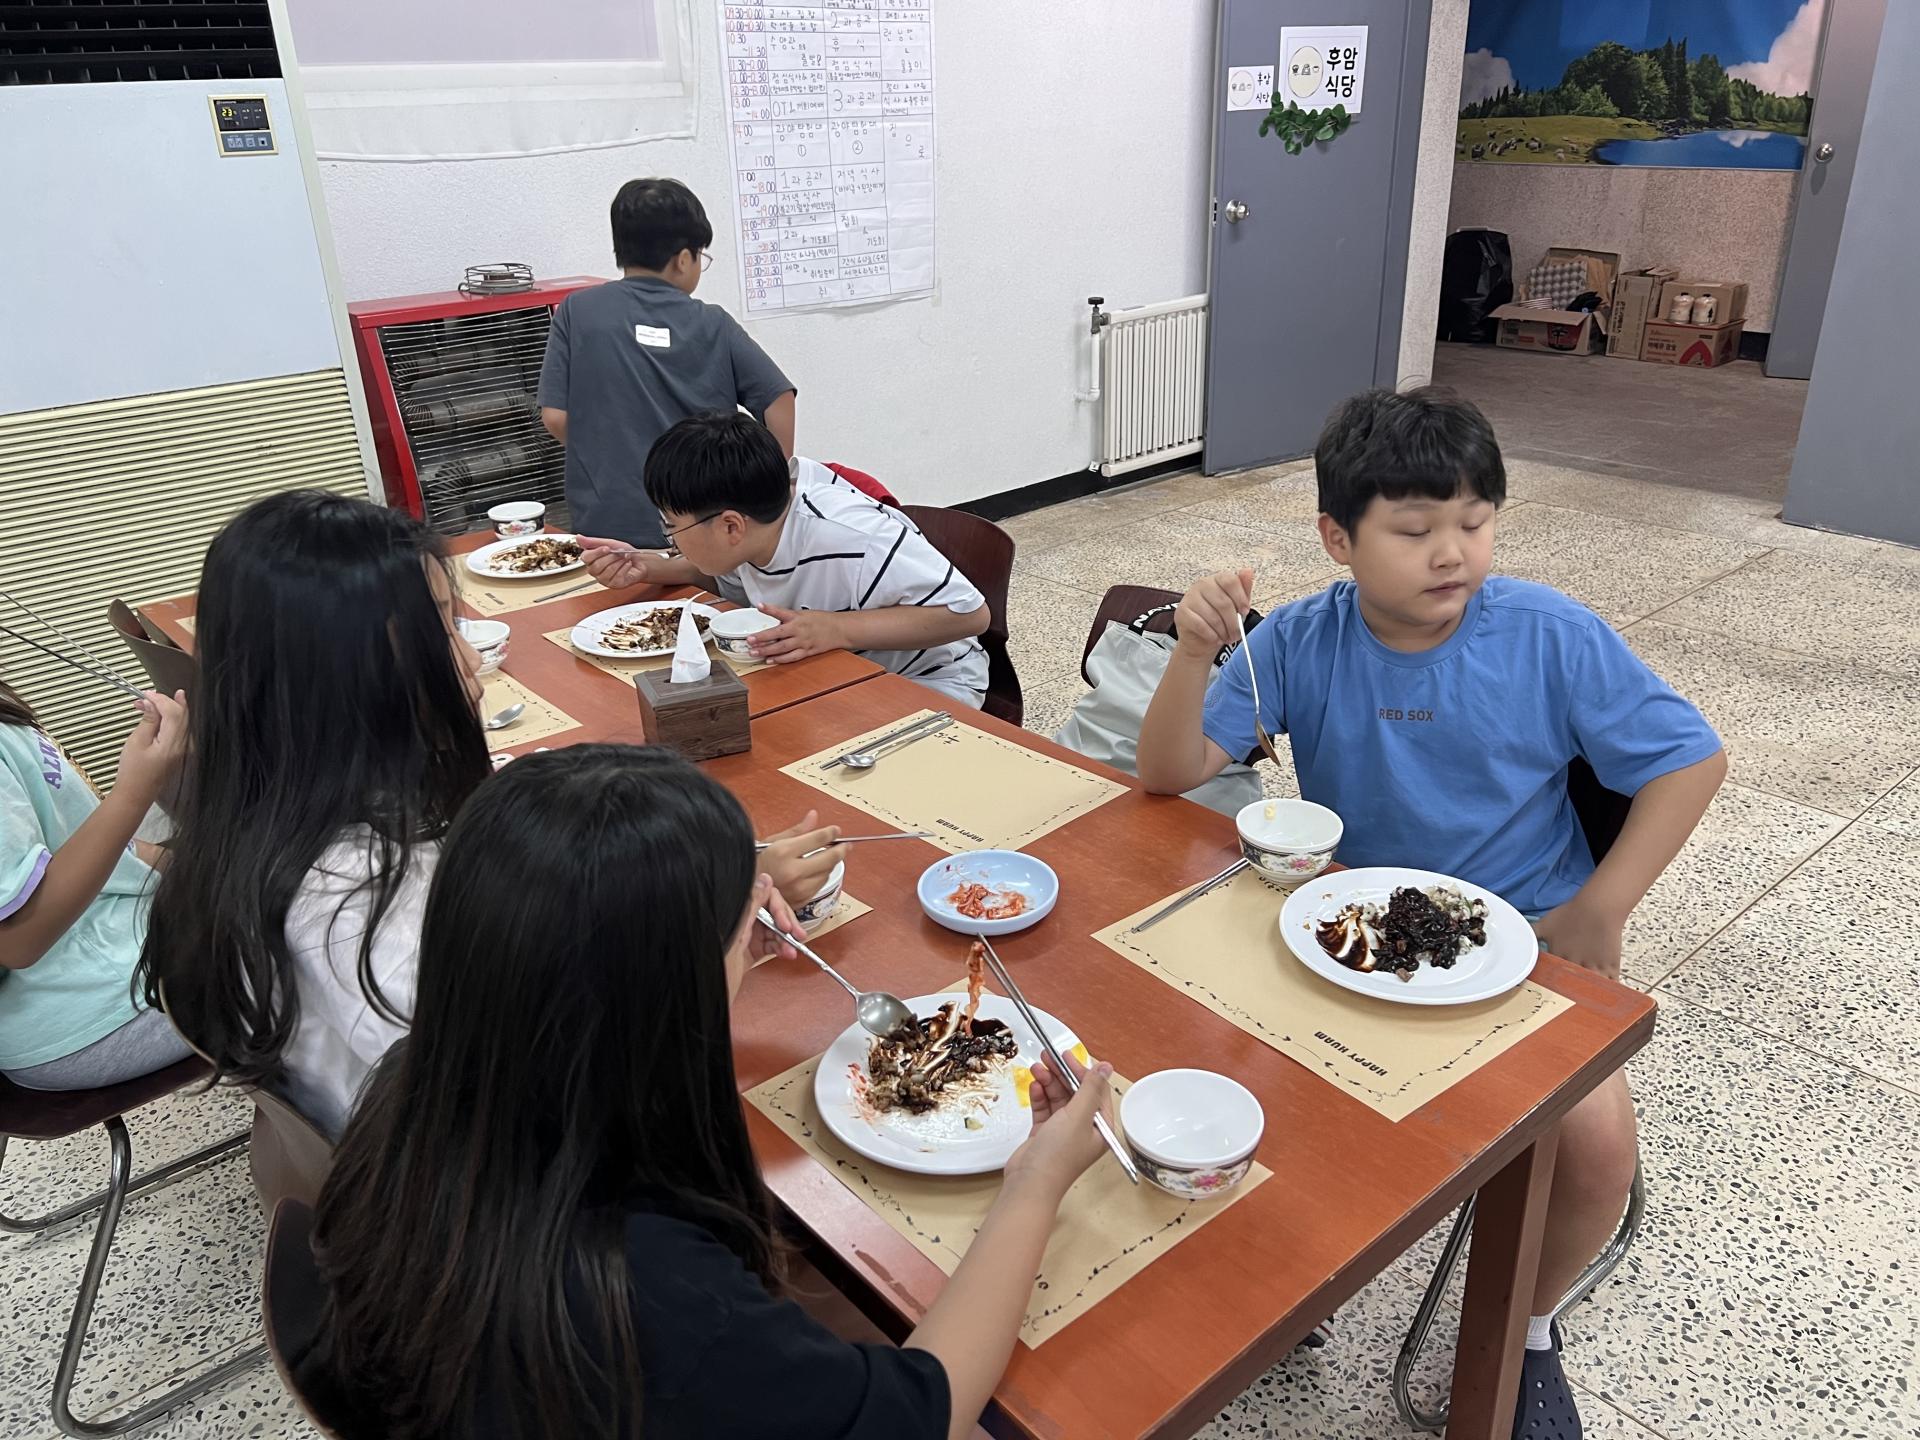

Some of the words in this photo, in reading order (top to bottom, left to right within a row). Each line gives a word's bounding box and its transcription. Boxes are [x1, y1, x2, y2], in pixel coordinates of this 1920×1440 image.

[1326, 46, 1358, 71] 후암
[1256, 72, 1271, 86] 후암
[1325, 74, 1356, 98] 식당
[1256, 92, 1270, 104] 식당
[1378, 708, 1404, 720] RED
[1407, 710, 1434, 722] SOX
[1314, 1031, 1349, 1054] HUAM
[1347, 1053, 1388, 1076] HAPPY
